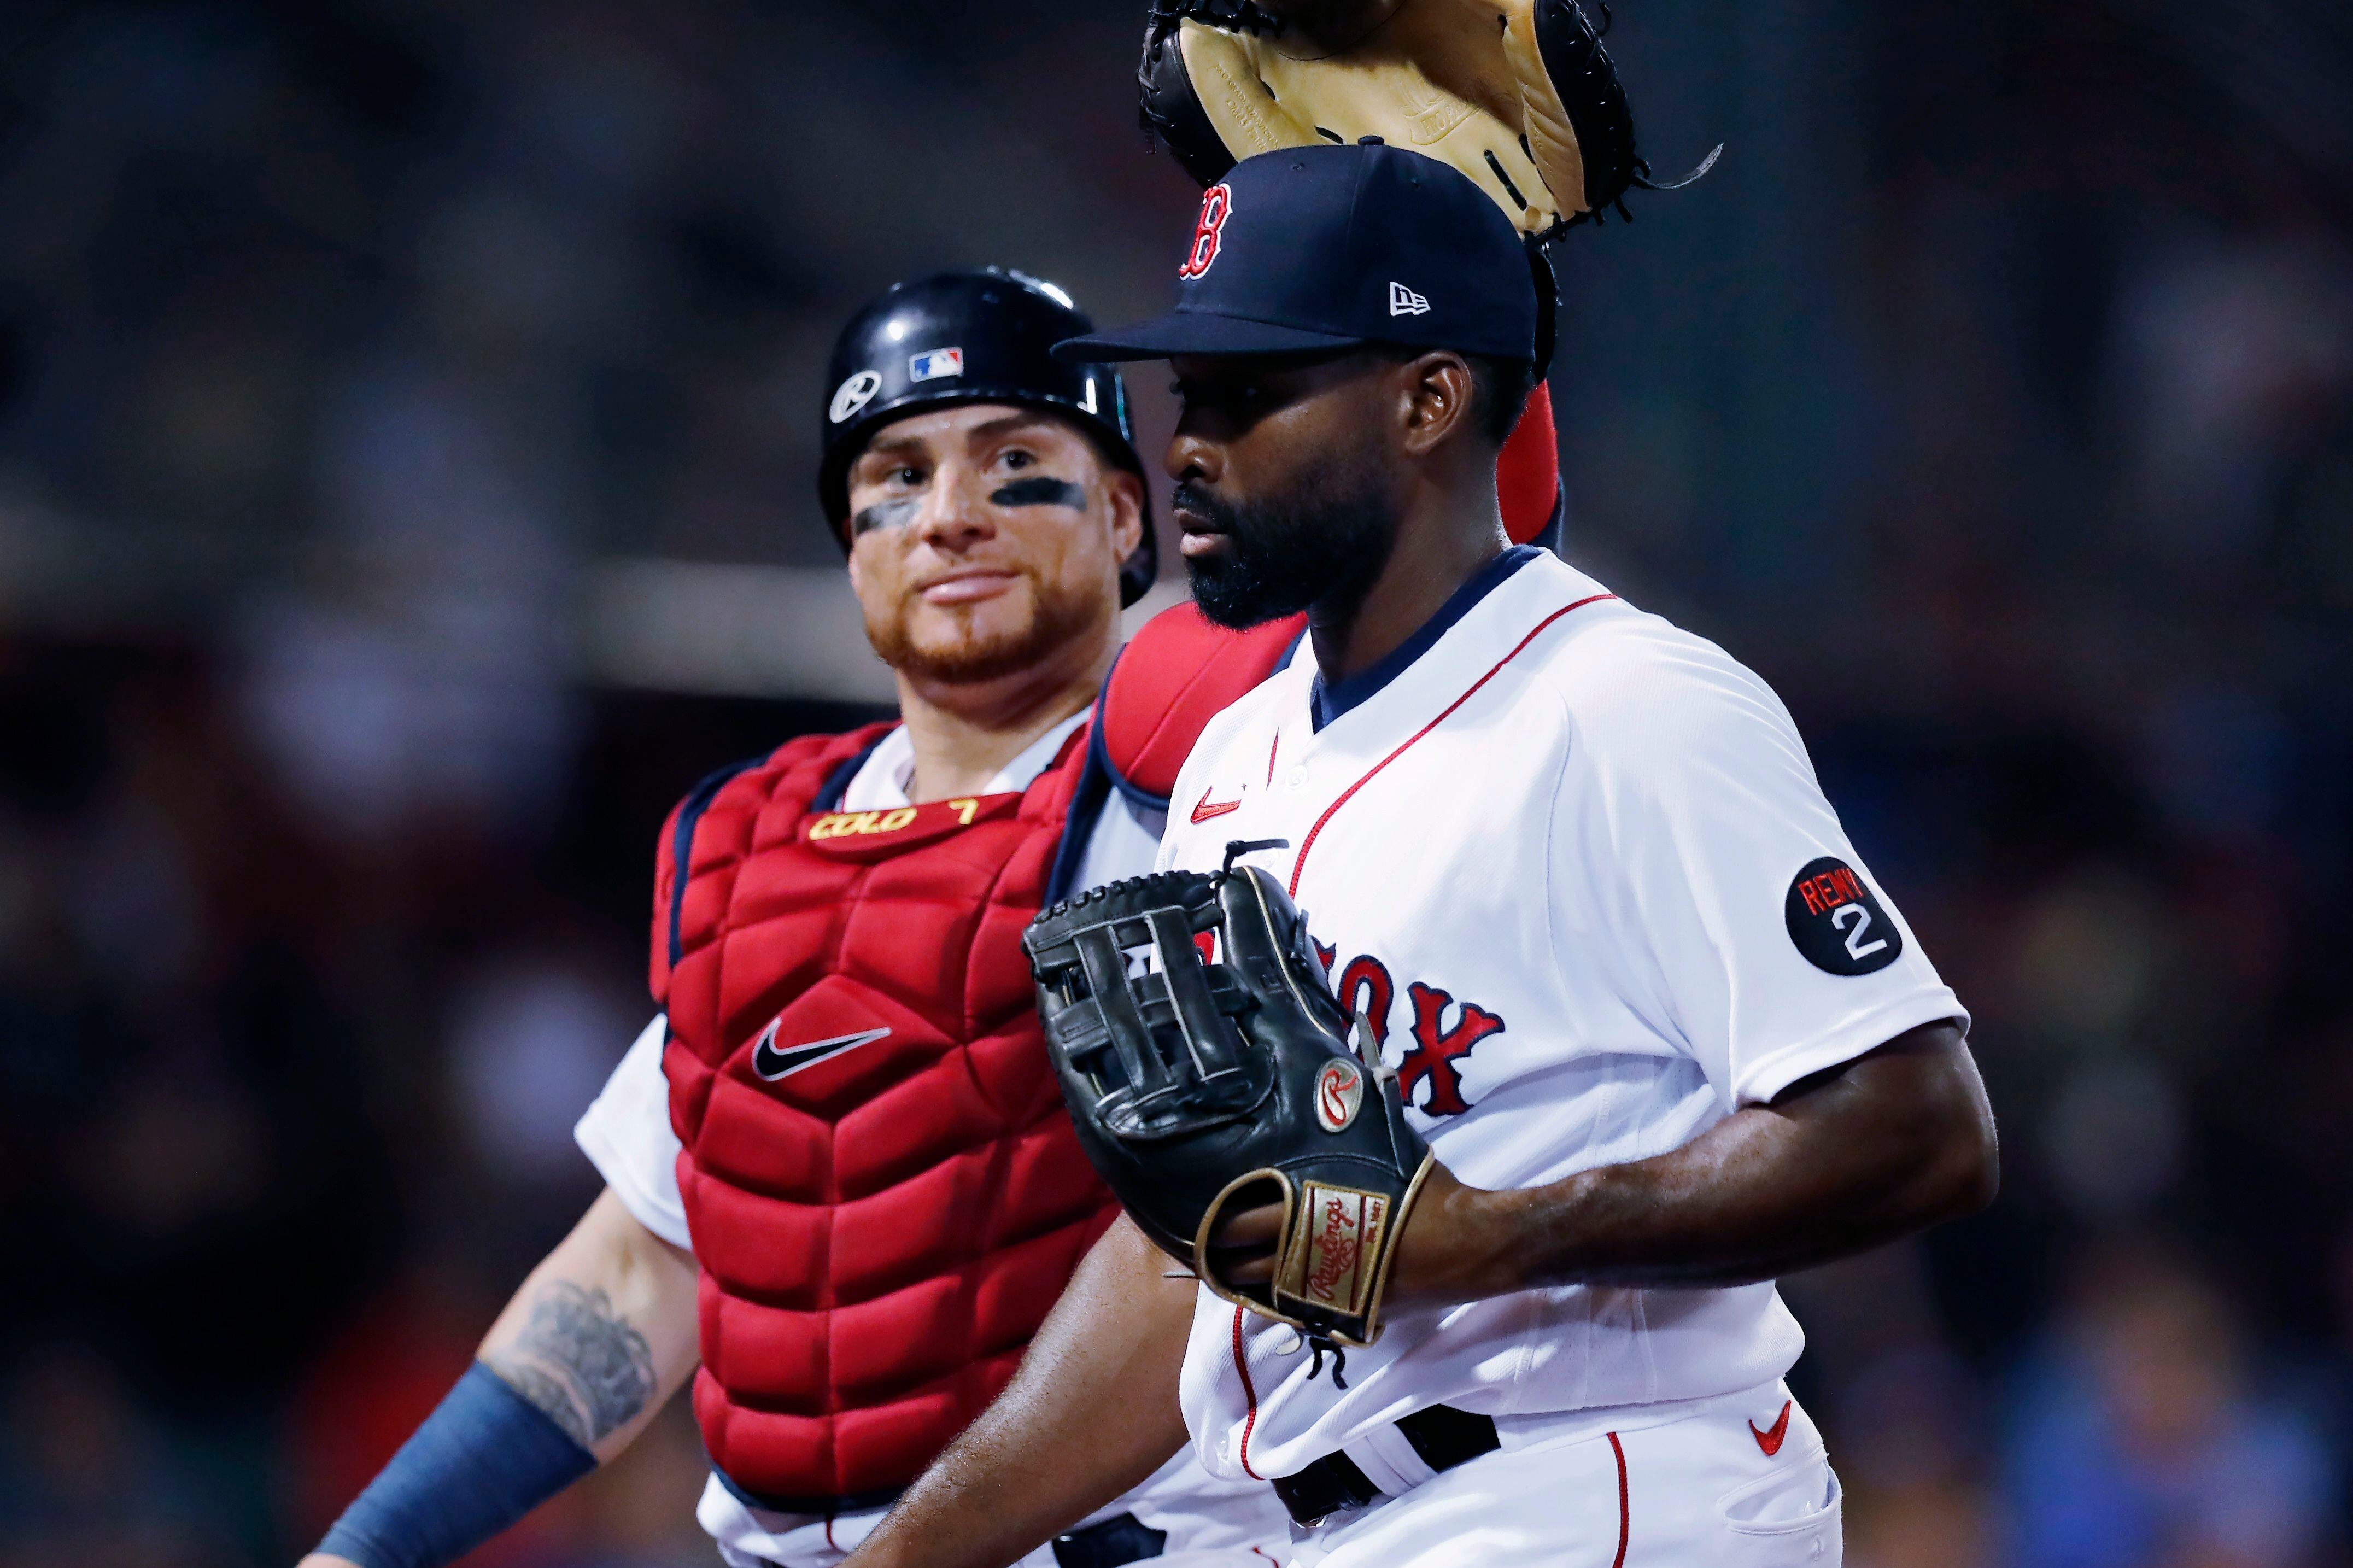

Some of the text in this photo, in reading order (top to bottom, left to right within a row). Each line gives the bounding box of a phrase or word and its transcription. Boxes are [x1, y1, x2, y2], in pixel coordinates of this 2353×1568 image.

[1179, 183, 1233, 281] B
[949, 799, 979, 825] 7
[1798, 867, 1863, 916] REMY
[1831, 903, 1888, 961] 2
[1310, 935, 1506, 1118] OX
[1307, 1197, 1356, 1302] Rawlings
